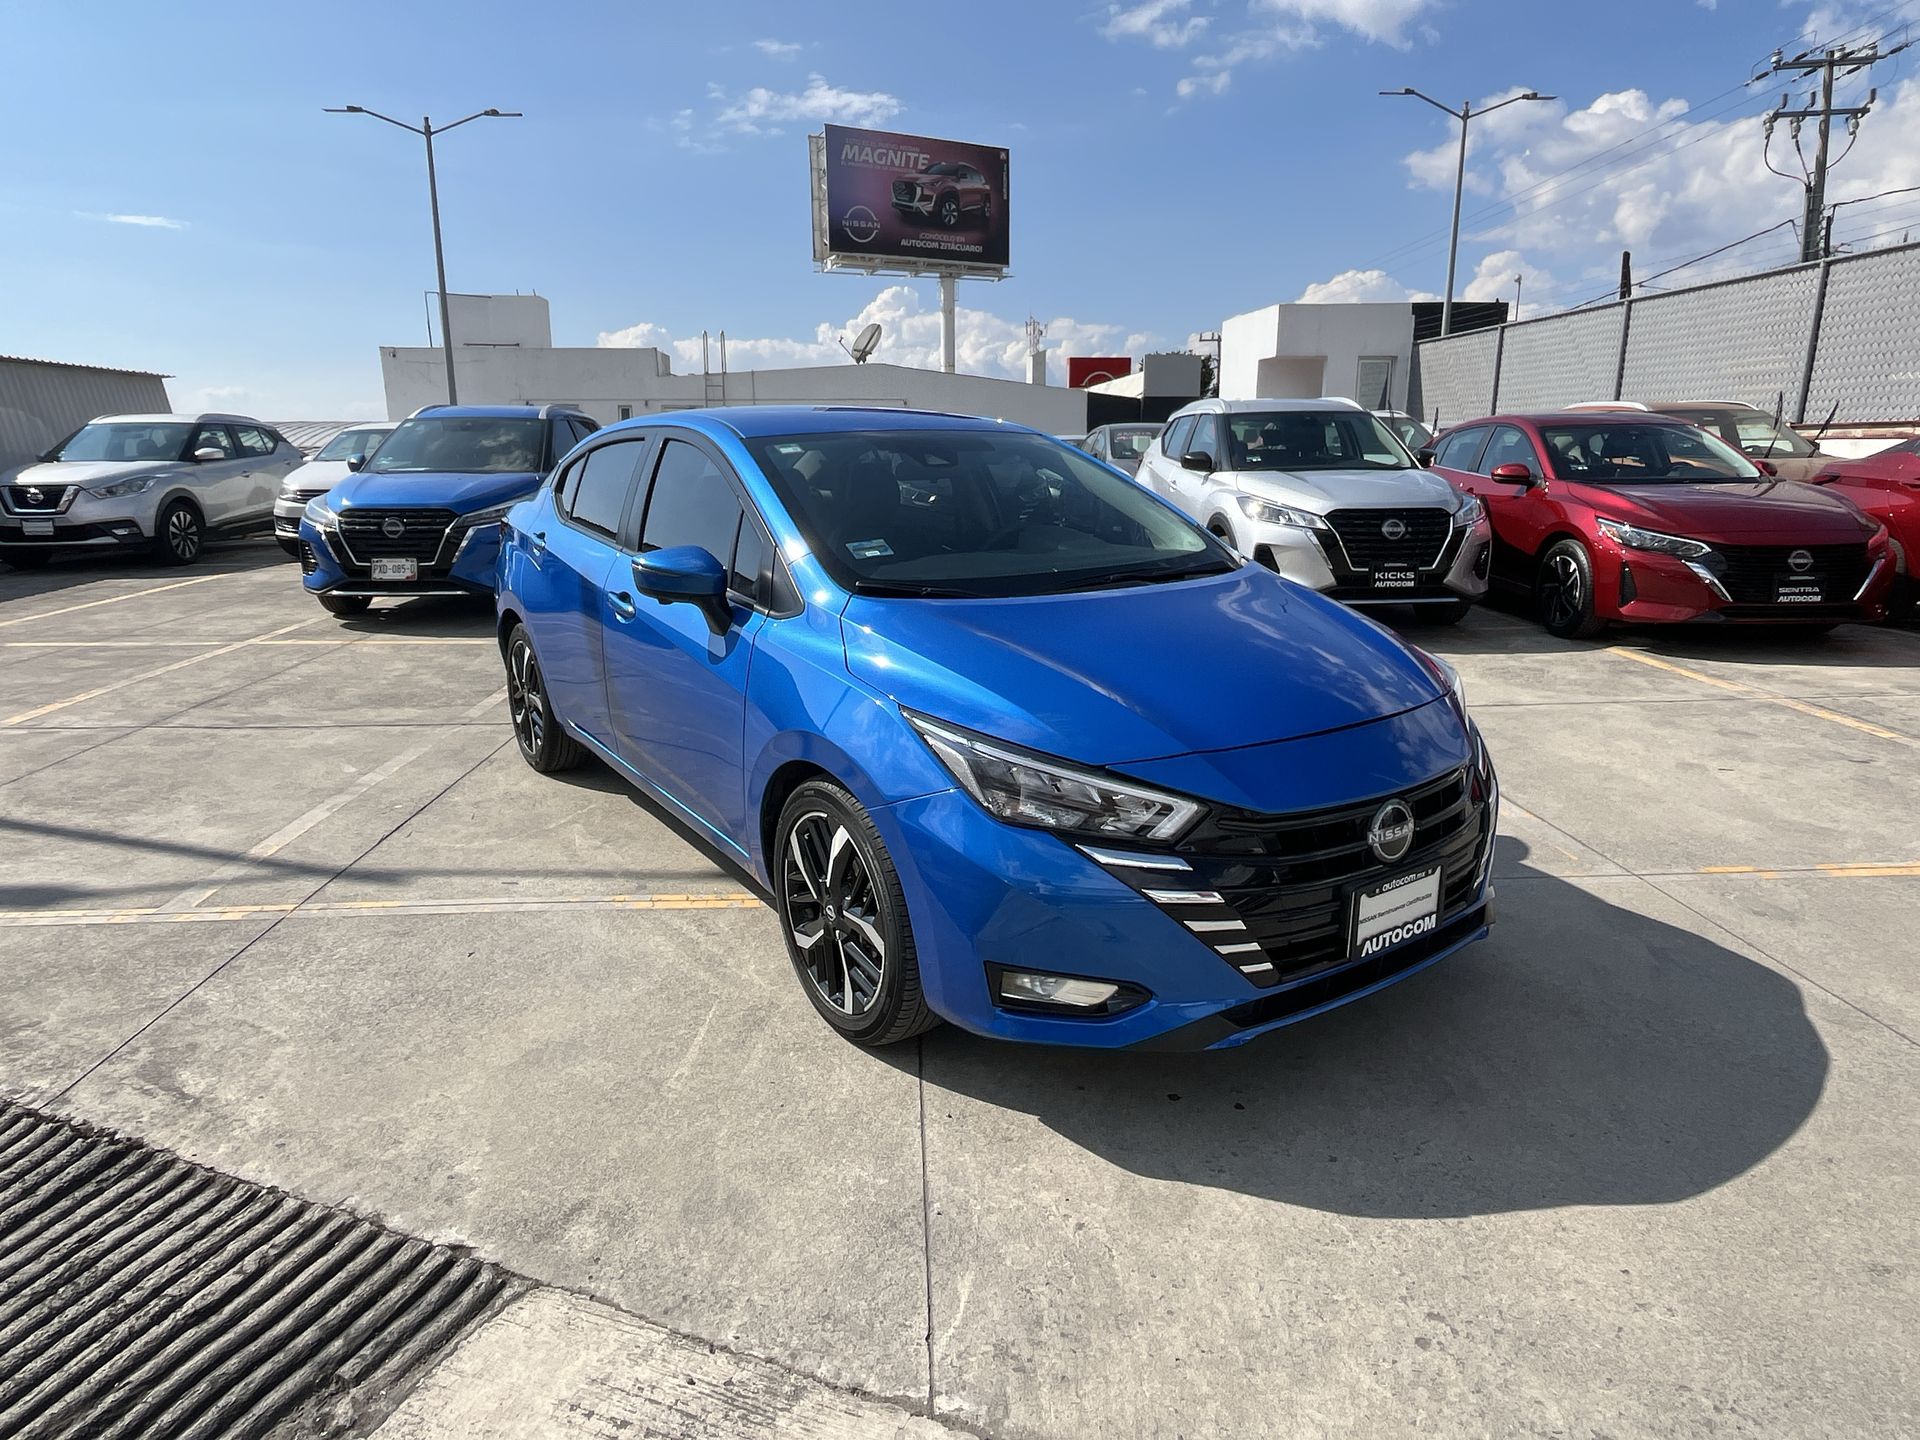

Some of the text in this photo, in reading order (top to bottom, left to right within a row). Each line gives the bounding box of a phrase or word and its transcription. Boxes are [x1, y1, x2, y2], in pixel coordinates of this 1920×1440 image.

[841, 143, 930, 169] MAGNITE
[841, 219, 880, 229] NISSAN
[900, 239, 939, 249] AUTOCOM
[1374, 571, 1415, 579] KICKS
[1777, 595, 1822, 603] AUTOCOM
[1368, 818, 1415, 843] NISSAN
[1382, 871, 1426, 892] autocom.mx
[1361, 913, 1437, 958] AUTOCOM
